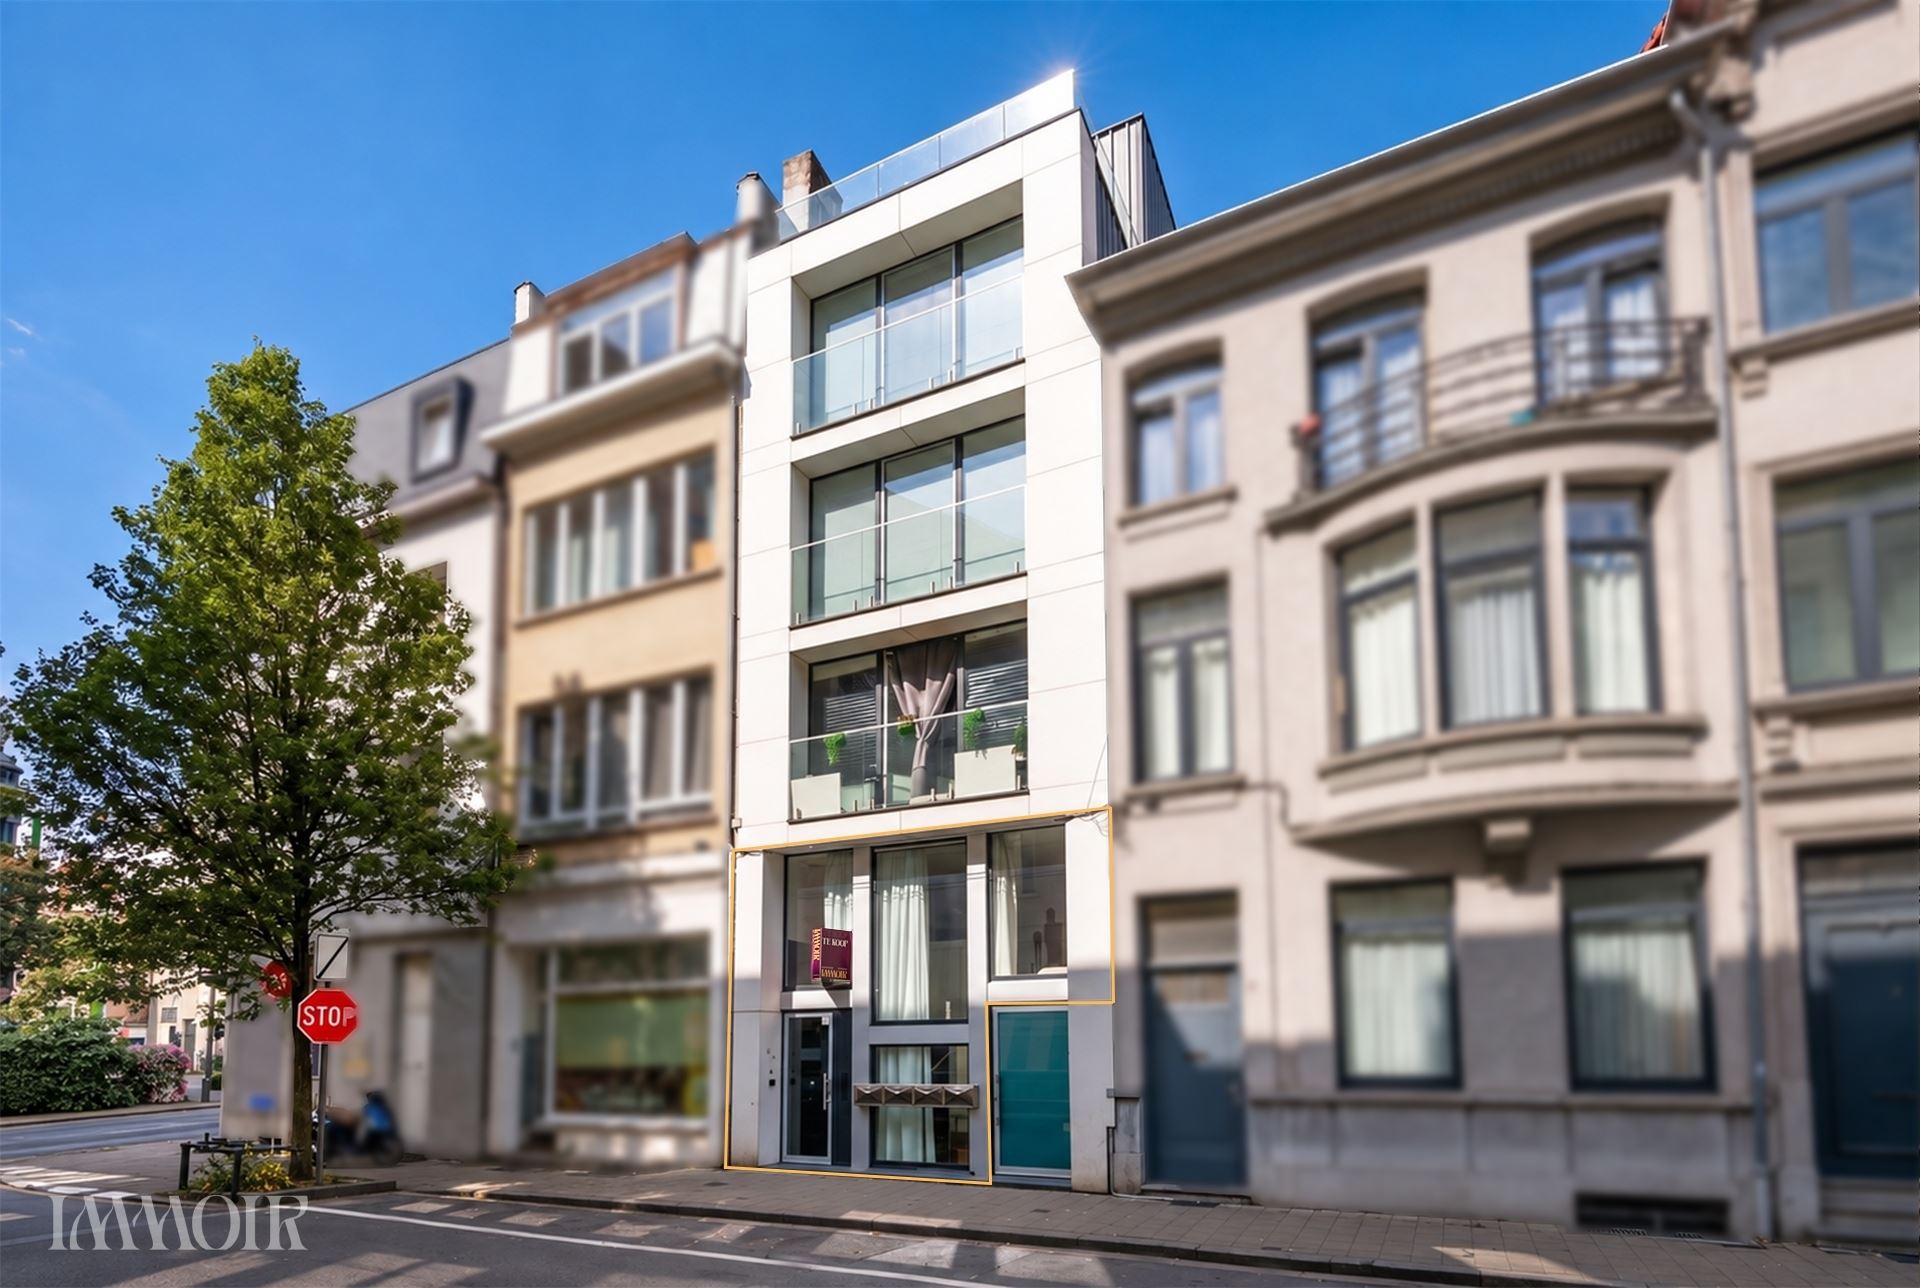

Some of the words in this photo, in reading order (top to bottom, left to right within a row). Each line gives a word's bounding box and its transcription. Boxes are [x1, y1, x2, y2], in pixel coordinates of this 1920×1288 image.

[823, 937, 831, 946] TE
[832, 938, 848, 948] KOOP
[302, 1005, 356, 1027] STOP
